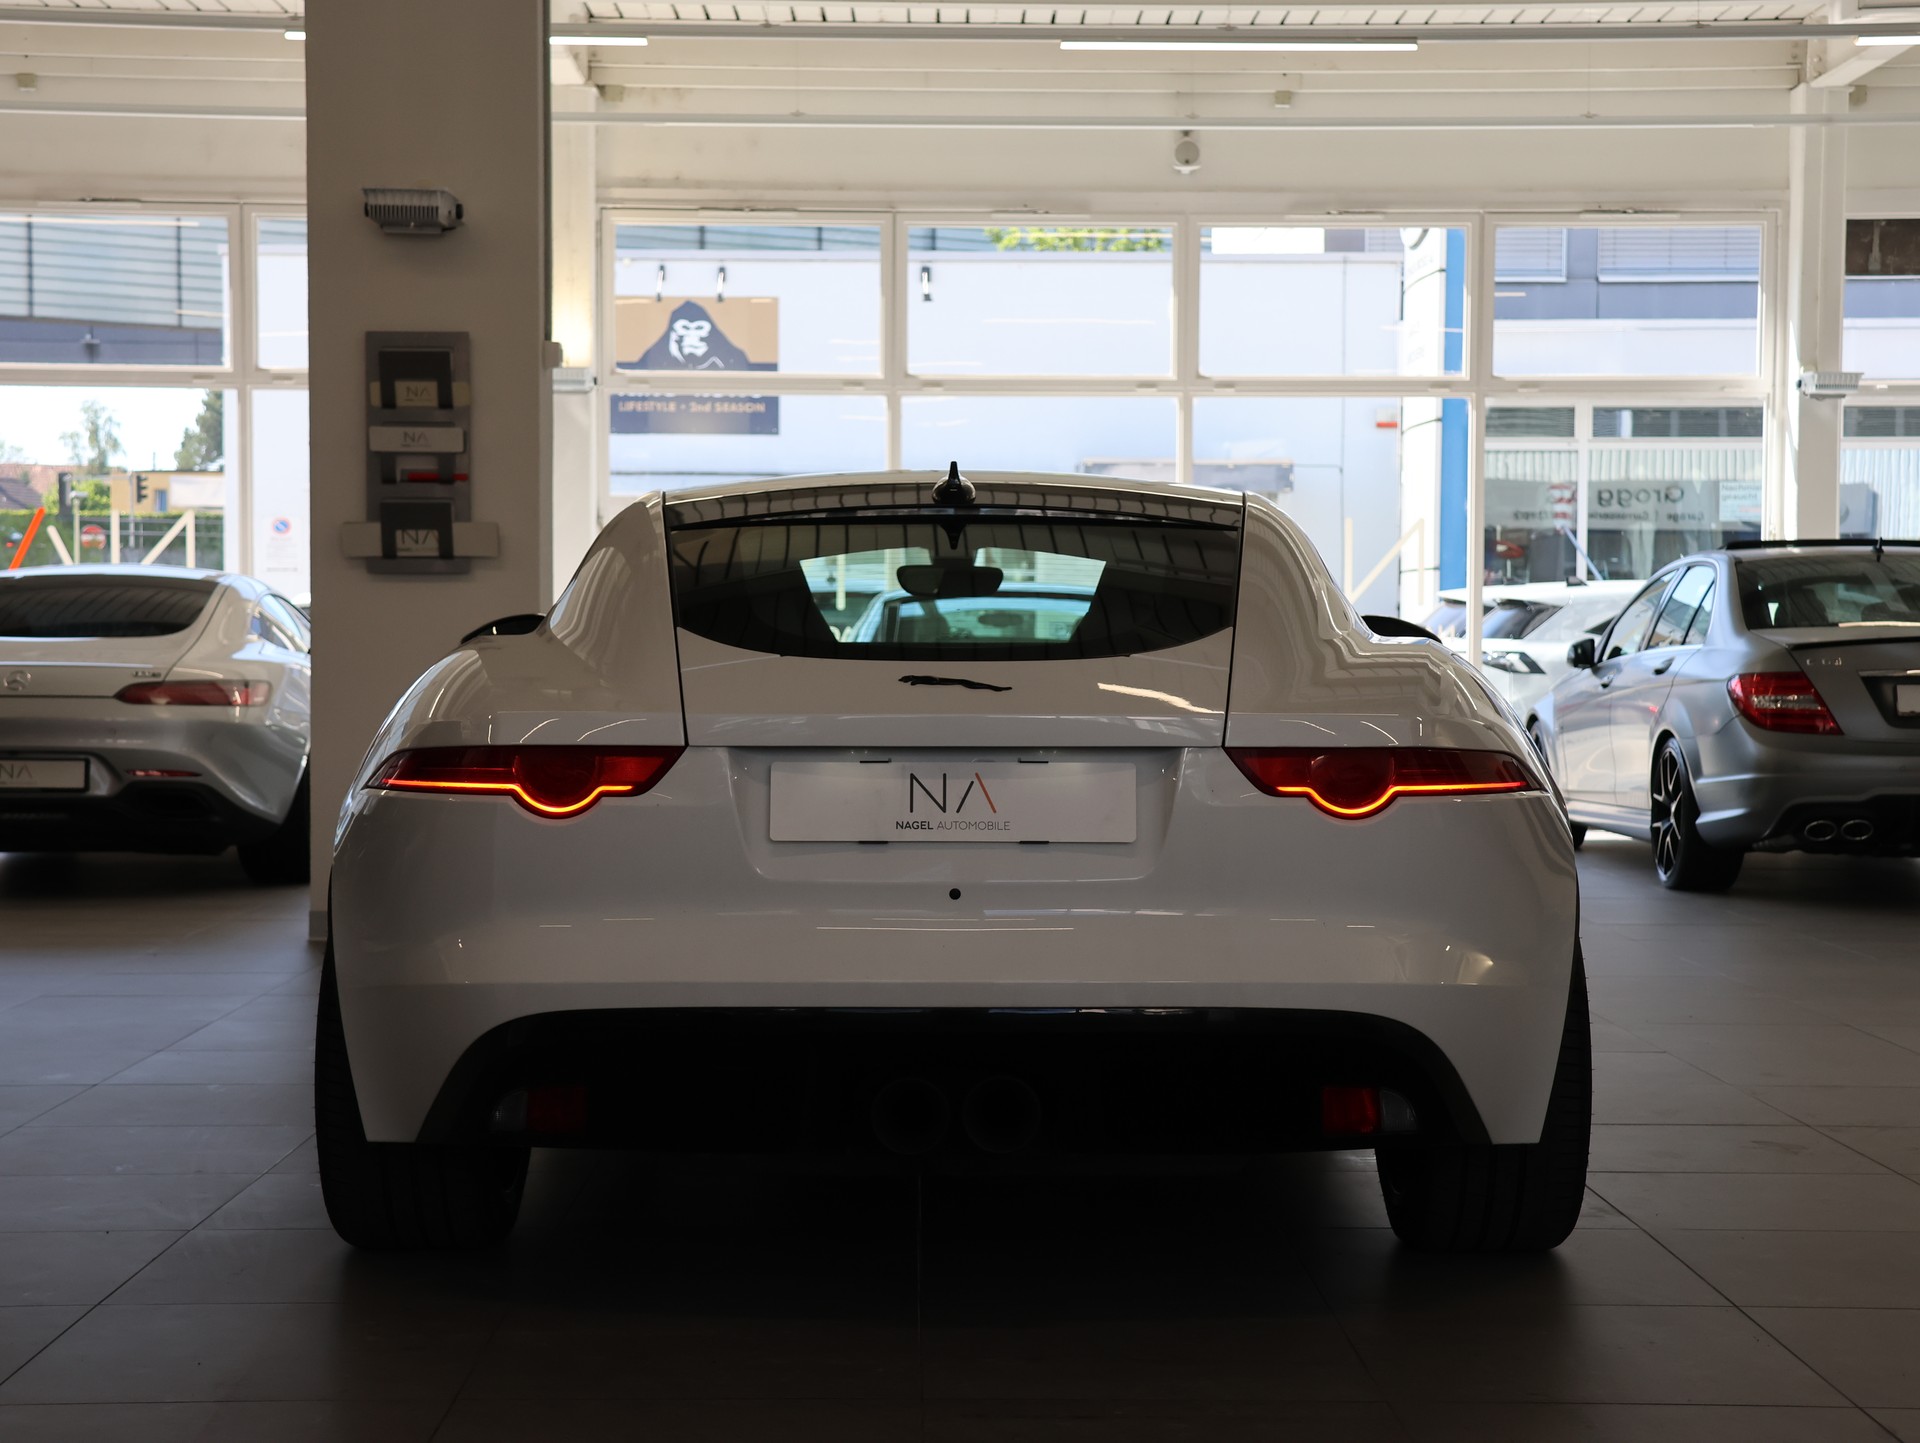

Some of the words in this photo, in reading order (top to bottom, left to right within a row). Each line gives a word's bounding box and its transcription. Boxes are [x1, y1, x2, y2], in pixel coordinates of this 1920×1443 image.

[618, 401, 676, 413] LIFESTYLE
[715, 402, 766, 413] SEASON
[909, 772, 997, 813] NA
[895, 821, 934, 830] NAGEL
[936, 821, 1011, 831] AUTOMOBILE
